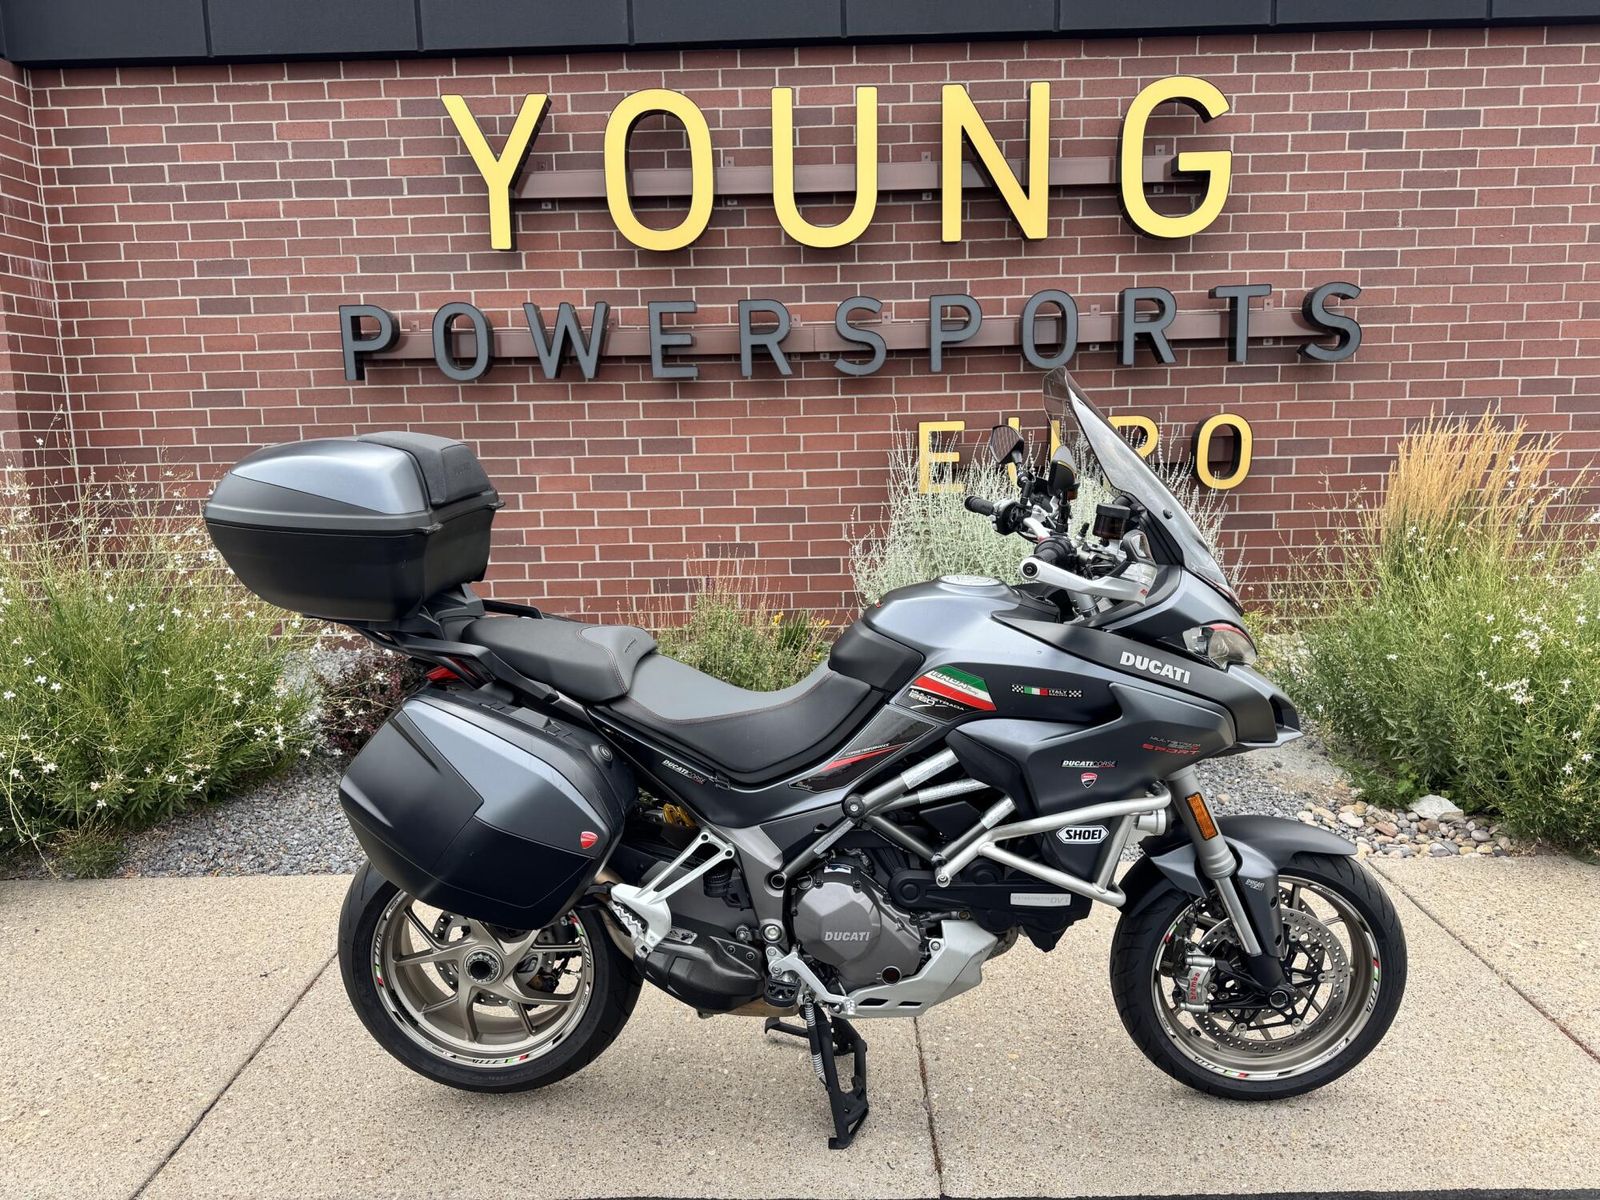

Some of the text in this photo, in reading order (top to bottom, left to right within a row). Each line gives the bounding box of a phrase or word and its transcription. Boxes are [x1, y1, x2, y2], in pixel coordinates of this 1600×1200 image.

[441, 75, 1233, 252] YOUNG
[338, 281, 1364, 382] POWERSPORTS
[1119, 651, 1191, 685] DUCATI
[1065, 829, 1102, 841] SHOEI
[824, 931, 871, 941] DUCATI
